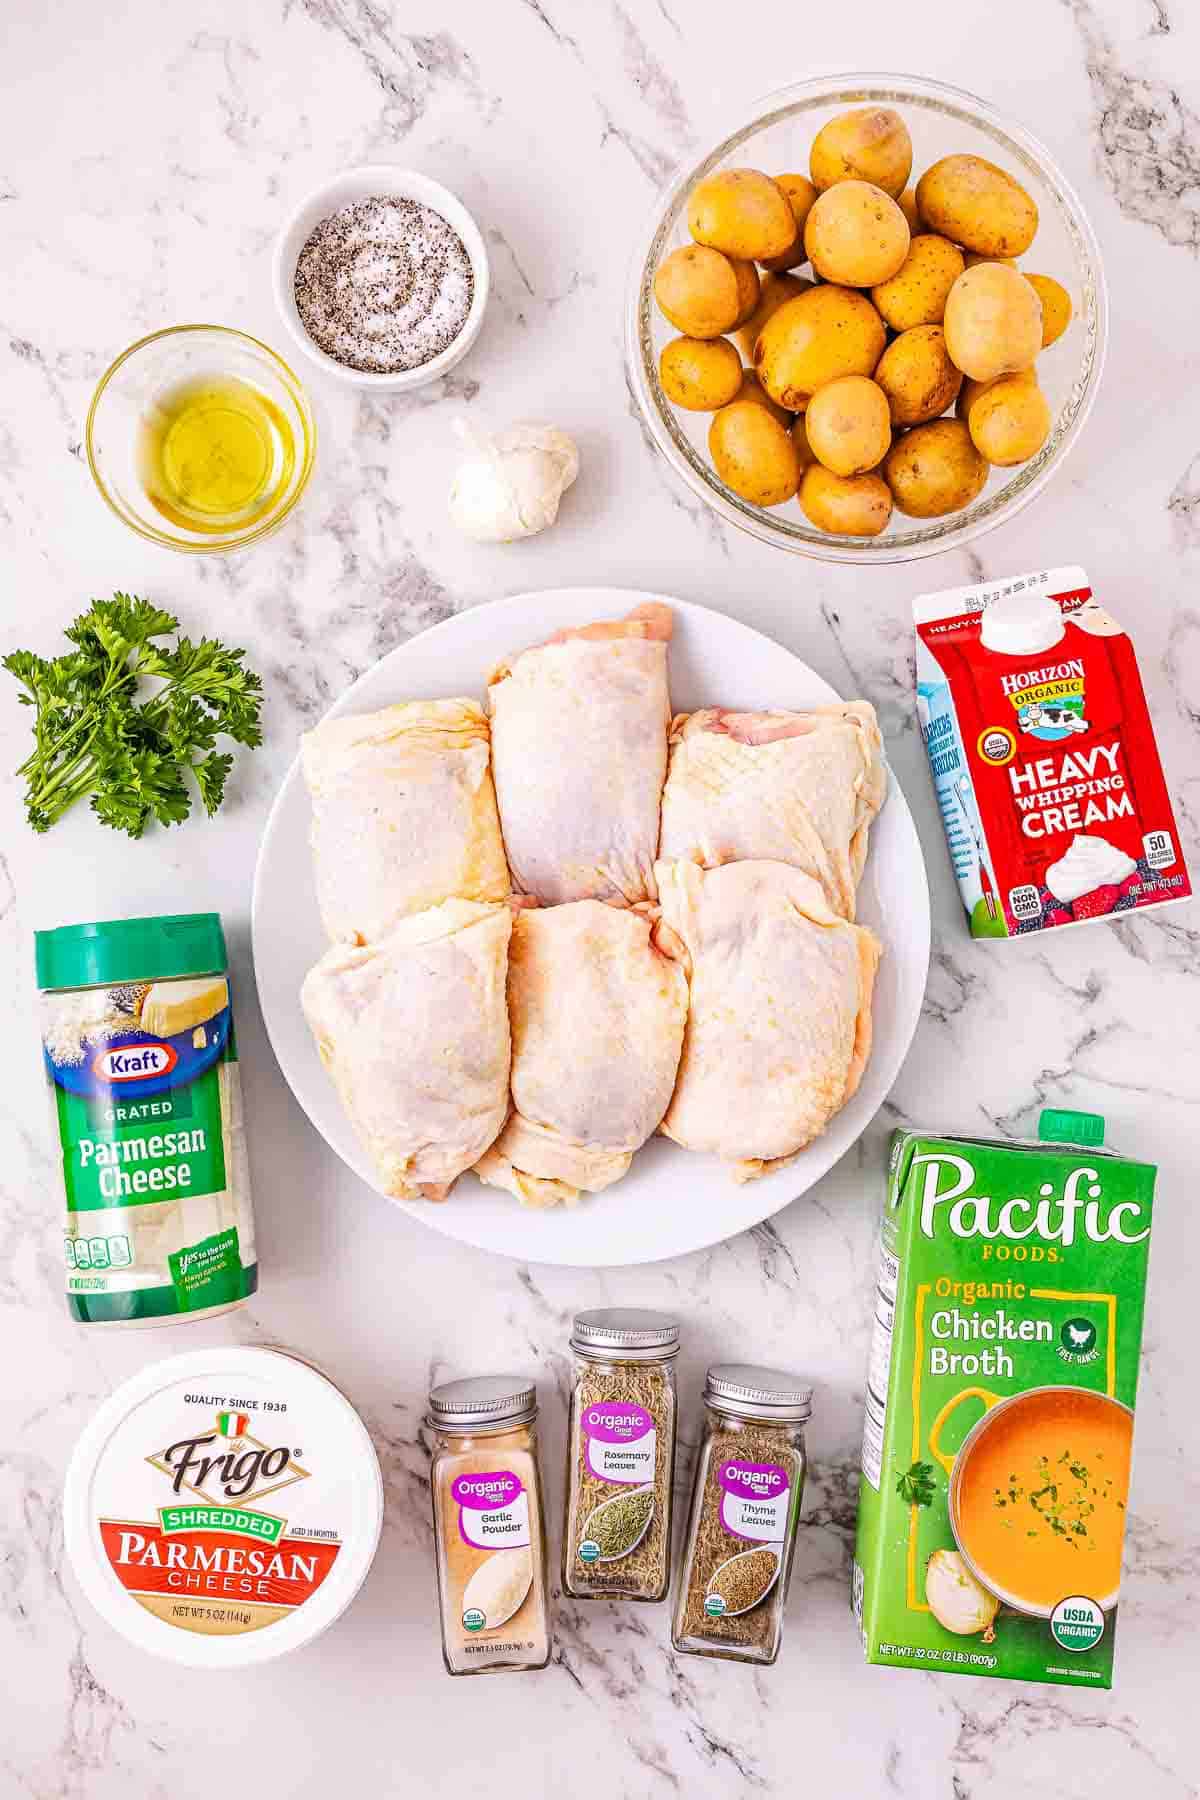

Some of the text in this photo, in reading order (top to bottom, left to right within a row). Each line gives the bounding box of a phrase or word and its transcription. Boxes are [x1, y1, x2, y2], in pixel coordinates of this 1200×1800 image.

[1000, 658, 1086, 696] HORIZON
[1015, 682, 1081, 704] ORGANIC
[1008, 742, 1121, 795] HEAVY
[1015, 775, 1125, 811] WHIPPING
[1022, 791, 1135, 838] CREAM
[1149, 835, 1166, 851] 50
[1012, 892, 1036, 905] NON
[1014, 901, 1039, 912] GMO
[110, 1051, 159, 1073] Kraft
[104, 1102, 173, 1121] GRATED
[78, 1127, 206, 1167] Parmesan
[99, 1162, 191, 1198] Cheese
[911, 1153, 1152, 1246] Pacific
[935, 1276, 1026, 1305] Organic
[930, 1308, 1054, 1341] Chicken
[929, 1346, 1014, 1378] Broth
[184, 1394, 288, 1413] QUALITY SINCE 1938
[588, 1412, 644, 1429] Organic
[163, 1434, 291, 1498] Frigo
[604, 1451, 651, 1461] Rosemary
[604, 1462, 636, 1470] Leaves
[727, 1466, 781, 1485] Organic
[458, 1478, 514, 1497] Organic
[481, 1512, 513, 1523] Garlic
[742, 1503, 777, 1515] Thyme
[168, 1510, 276, 1536] SHREDDED
[482, 1523, 522, 1534] Powder
[741, 1514, 776, 1527] Leaves
[115, 1531, 320, 1582] PARMESAN
[167, 1571, 271, 1595] CHEESE
[172, 1606, 190, 1617] NET
[191, 1607, 205, 1618] WT
[206, 1608, 212, 1619] 5
[212, 1609, 225, 1621] OZ
[1063, 1608, 1094, 1623] USDA
[1058, 1624, 1097, 1638] ORGANIC
[879, 1643, 897, 1656] NET
[914, 1648, 925, 1658] 32
[970, 1654, 998, 1669] (907g)
